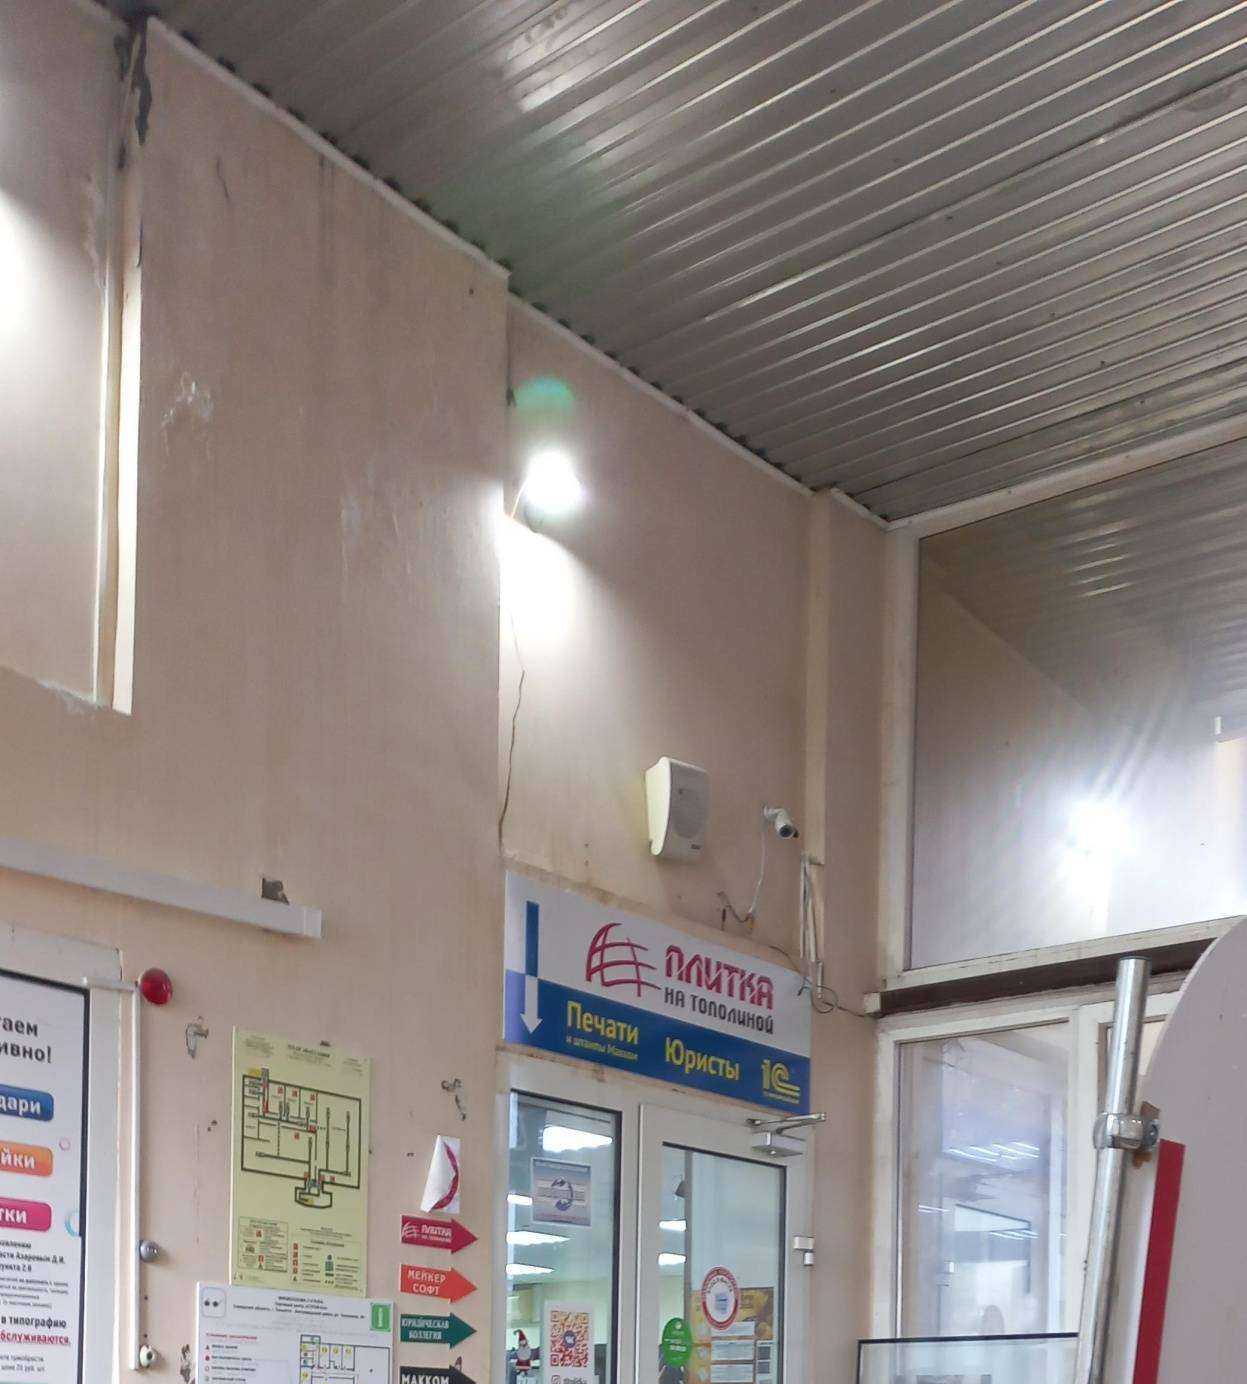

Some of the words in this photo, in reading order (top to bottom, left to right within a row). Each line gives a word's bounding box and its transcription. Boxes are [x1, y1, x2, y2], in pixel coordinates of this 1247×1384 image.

[665, 944, 774, 1010] ПЛИТКА
[0, 1016, 39, 1037] аем
[566, 1000, 640, 1045] Печати
[664, 986, 685, 1009] НА
[690, 993, 774, 1035] ТОПОЛИНОЙ
[665, 1036, 741, 1082] Юристы
[408, 1269, 446, 1283] МЕЙКЕР
[412, 1283, 440, 1295] СОФТ
[9, 1316, 67, 1330] типографию
